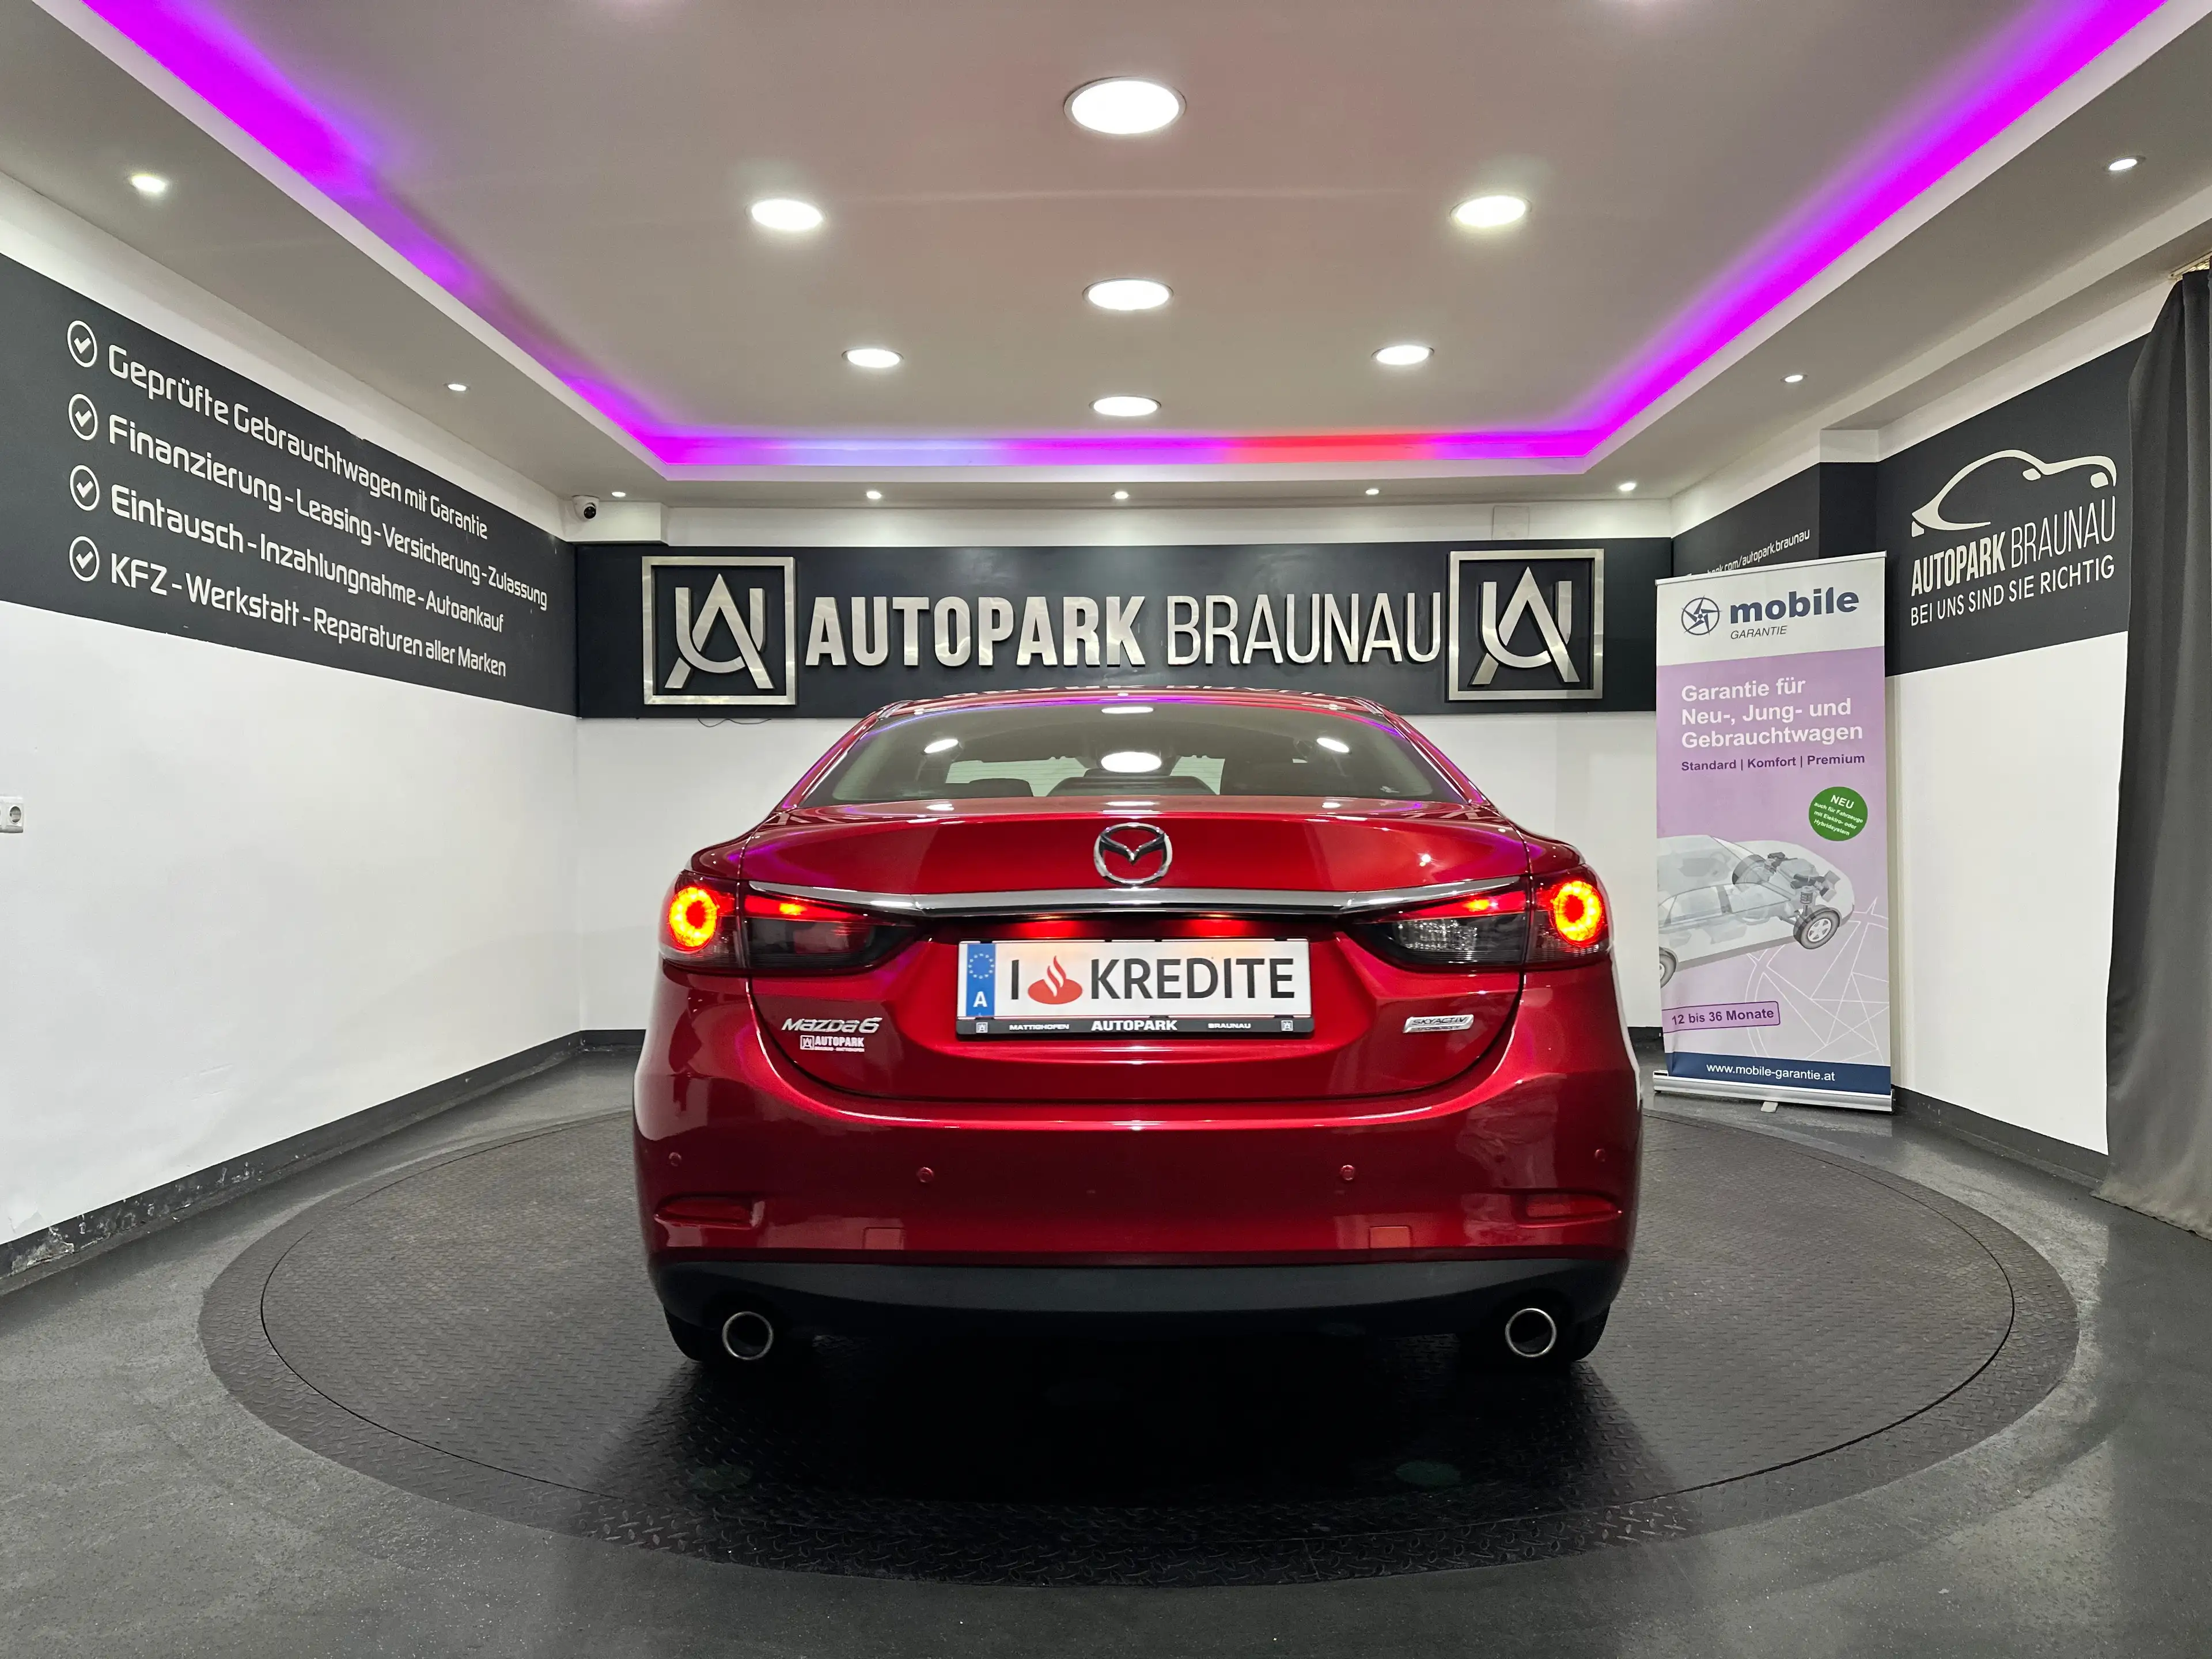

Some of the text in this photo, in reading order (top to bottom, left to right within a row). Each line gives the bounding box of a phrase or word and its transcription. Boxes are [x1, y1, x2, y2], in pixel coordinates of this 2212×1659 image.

[108, 344, 488, 540] Geprüfte Gebrauchtwagen mit Garantie
[1911, 495, 2116, 597] AUTOPARK BRAUNAU
[1911, 554, 2115, 627] BEI UNS SIND SIE RICHTIG
[1730, 586, 1860, 624] mobile
[805, 592, 1441, 668] AUTOPARK BRAUNAU
[1730, 625, 1788, 640] GARANTIE
[425, 639, 455, 665] aller
[458, 645, 506, 677] Marken
[1681, 677, 1806, 702] Garantie für
[1681, 698, 1851, 726] Neu-, Jung- und
[1681, 725, 1863, 749] Gebrauchtwagen
[1681, 761, 1737, 771] Standard
[1747, 756, 1797, 768] Komfort
[1806, 753, 1865, 766] Premium
[1813, 802, 1827, 810] auch
[1830, 794, 1855, 809] NEU
[1813, 819, 1850, 836] Hybridsystem
[1010, 957, 1295, 1000] I KREDITE
[972, 991, 988, 1007] A
[1091, 1020, 1177, 1031] AUTOPARK
[1411, 1016, 1468, 1025] SKYACTIV
[1672, 1008, 1775, 1026] 12 bis 36 Monate
[815, 1035, 865, 1047] AUTOPARK
[1706, 1063, 1836, 1082] www.mobile-garantie.at
